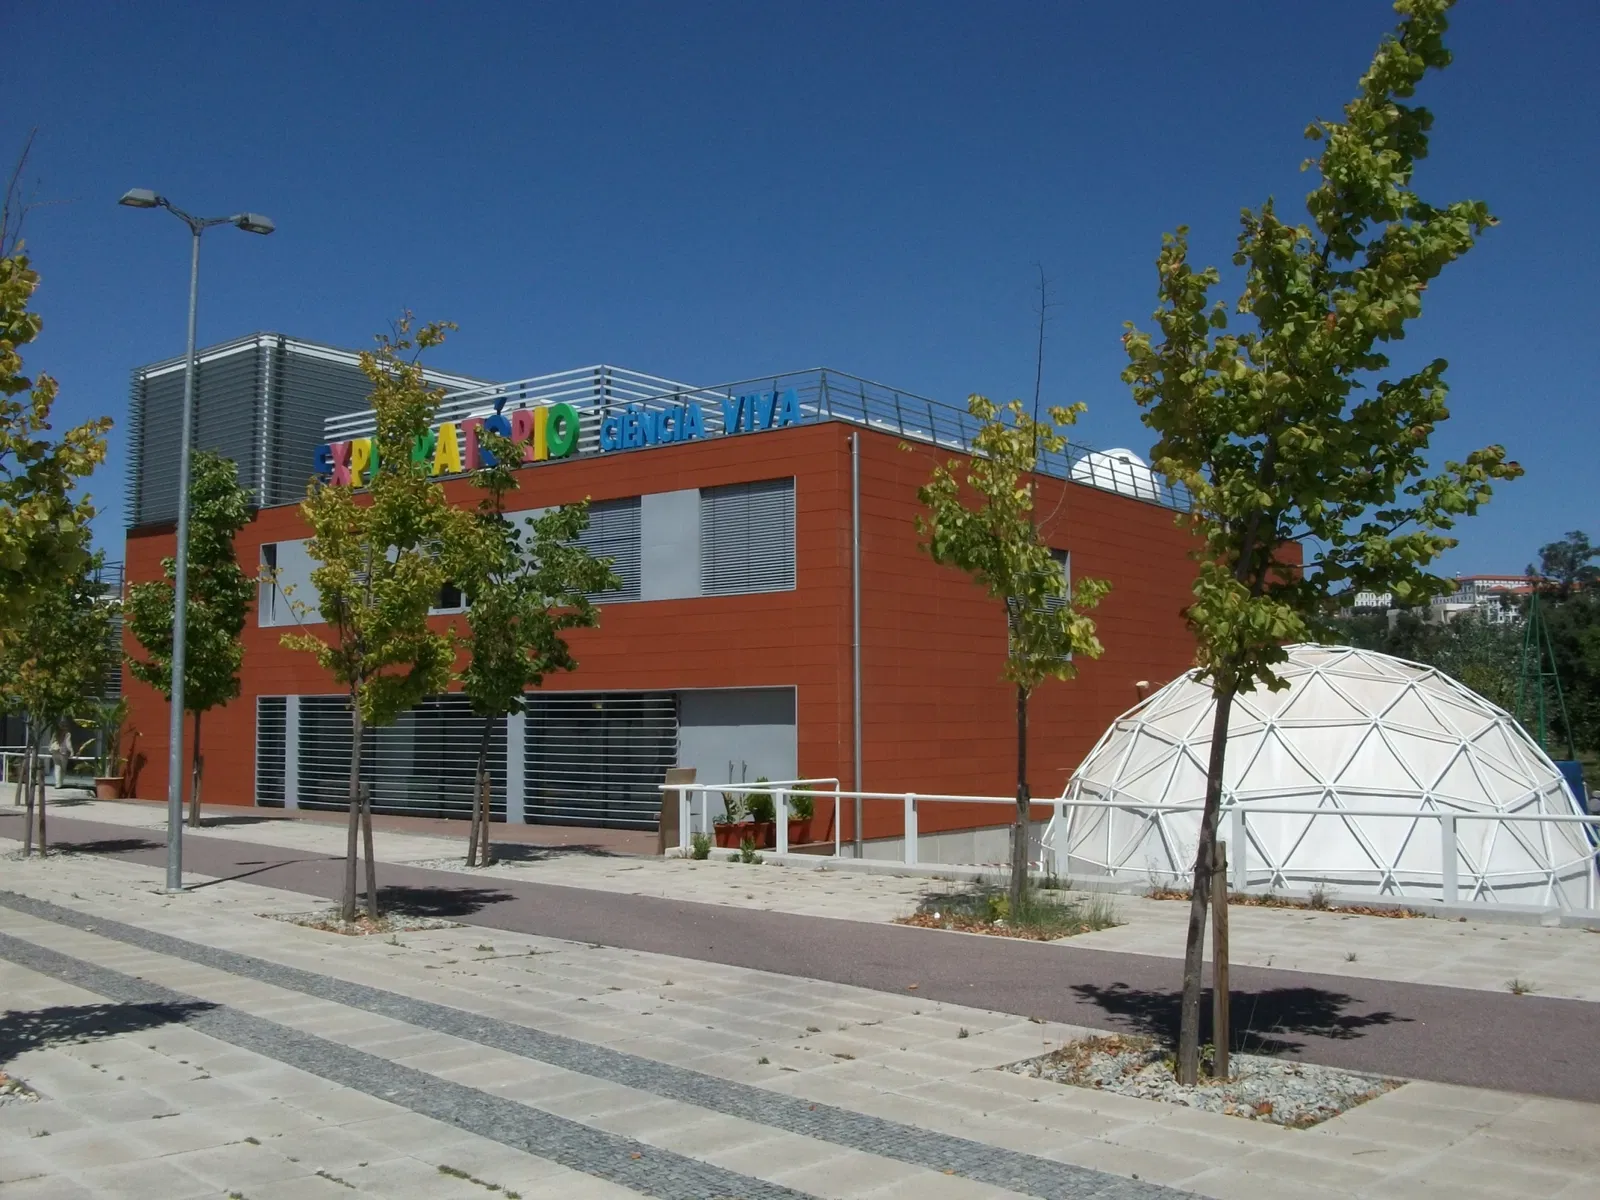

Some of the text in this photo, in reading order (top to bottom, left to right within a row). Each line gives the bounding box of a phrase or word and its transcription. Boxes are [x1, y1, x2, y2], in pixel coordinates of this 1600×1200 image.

[314, 387, 800, 487] EXPRATÓRIO CIÊNCIA VIVA
